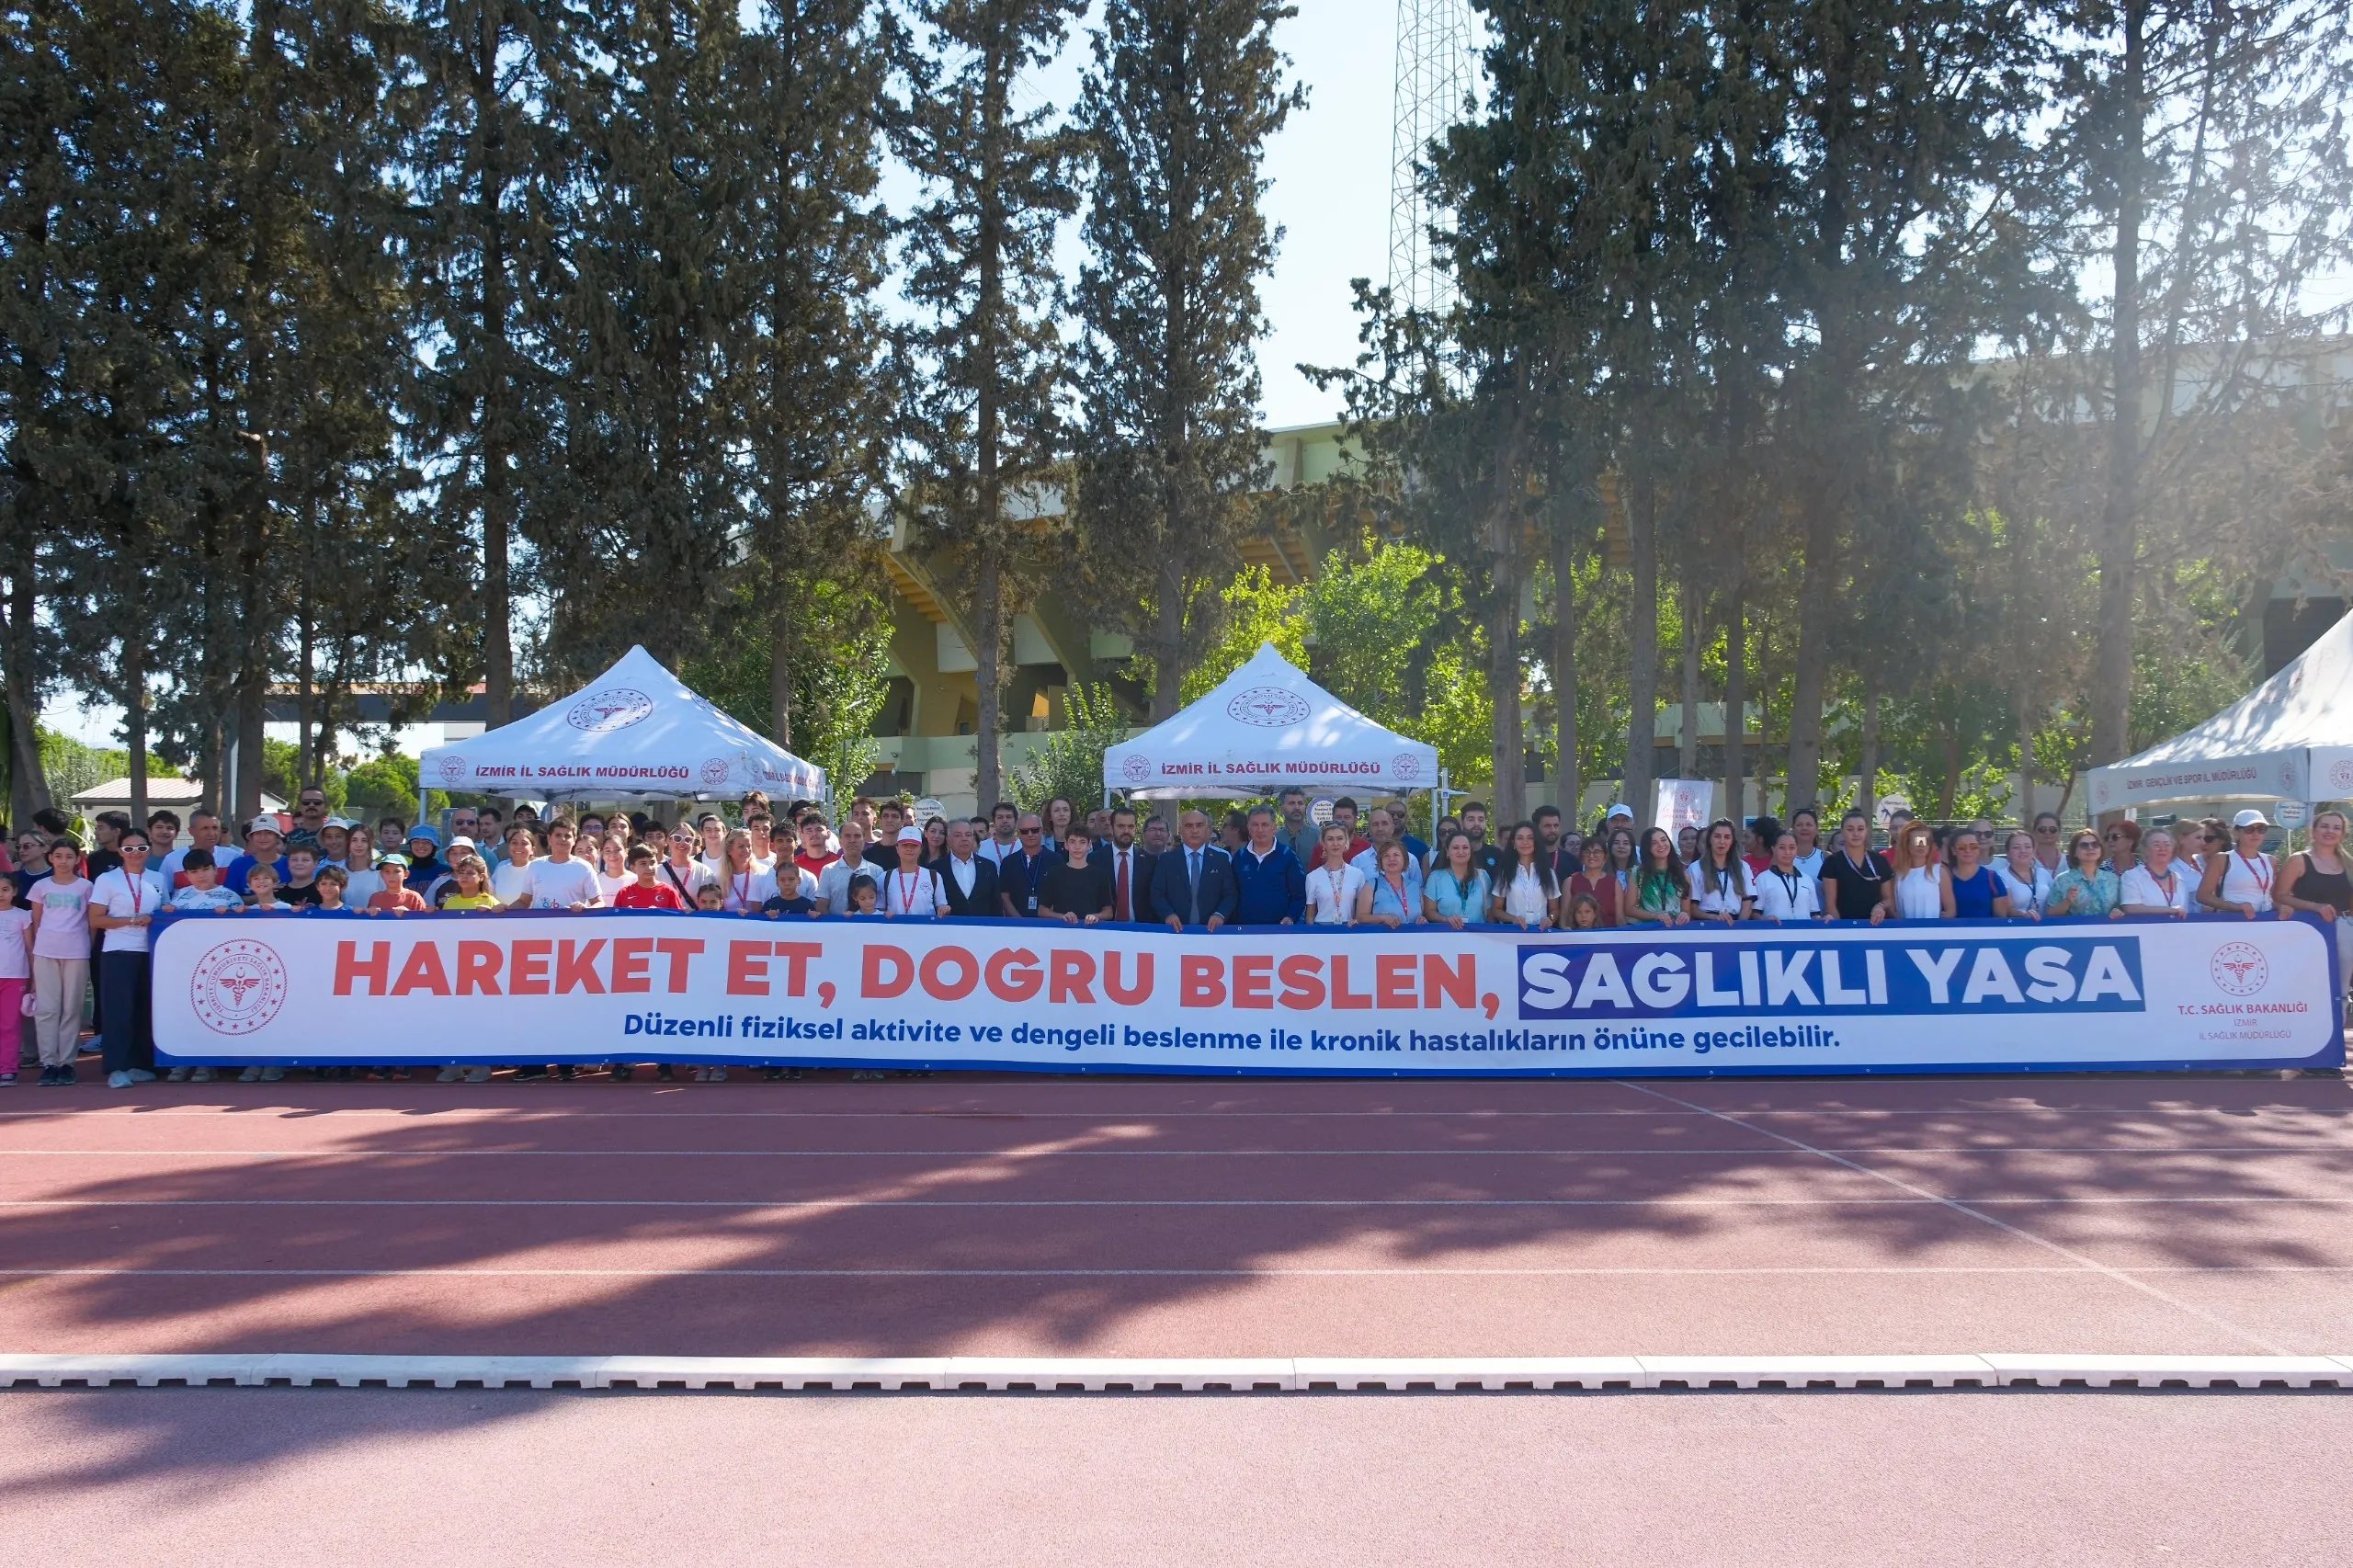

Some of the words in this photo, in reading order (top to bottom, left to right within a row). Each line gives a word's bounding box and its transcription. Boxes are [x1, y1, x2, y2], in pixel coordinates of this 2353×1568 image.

[475, 765, 517, 777] İZMİR
[520, 765, 534, 778] İL
[538, 765, 593, 778] SAĞLIK
[596, 765, 689, 779] MÜDÜRLÜĞÜ
[1161, 762, 1203, 775] İZMİR
[1208, 761, 1222, 774] İL
[1225, 760, 1281, 774] SAĞLIK
[1285, 760, 1381, 775] MÜDÜRLÜĞÜ
[334, 937, 705, 996] HAREKET
[727, 940, 836, 1009] ET,
[1180, 954, 1500, 1020] BESLEN,
[2177, 1005, 2199, 1015] T.C.
[2200, 1003, 2244, 1015] SAĞLIK
[2246, 1001, 2308, 1014] BAKANLIĞI
[624, 1013, 733, 1039] Düzenli
[741, 1015, 843, 1040] fiziksel
[851, 1017, 961, 1042] aktivite
[970, 1026, 1003, 1043] ve
[1011, 1022, 1115, 1051] dengeli
[1123, 1025, 1262, 1050] beslenme
[1270, 1028, 1302, 1051] ile
[1311, 1028, 1402, 1051] kronik
[1409, 1028, 1586, 1051] hastalıkların
[1593, 1027, 1686, 1051] önüne
